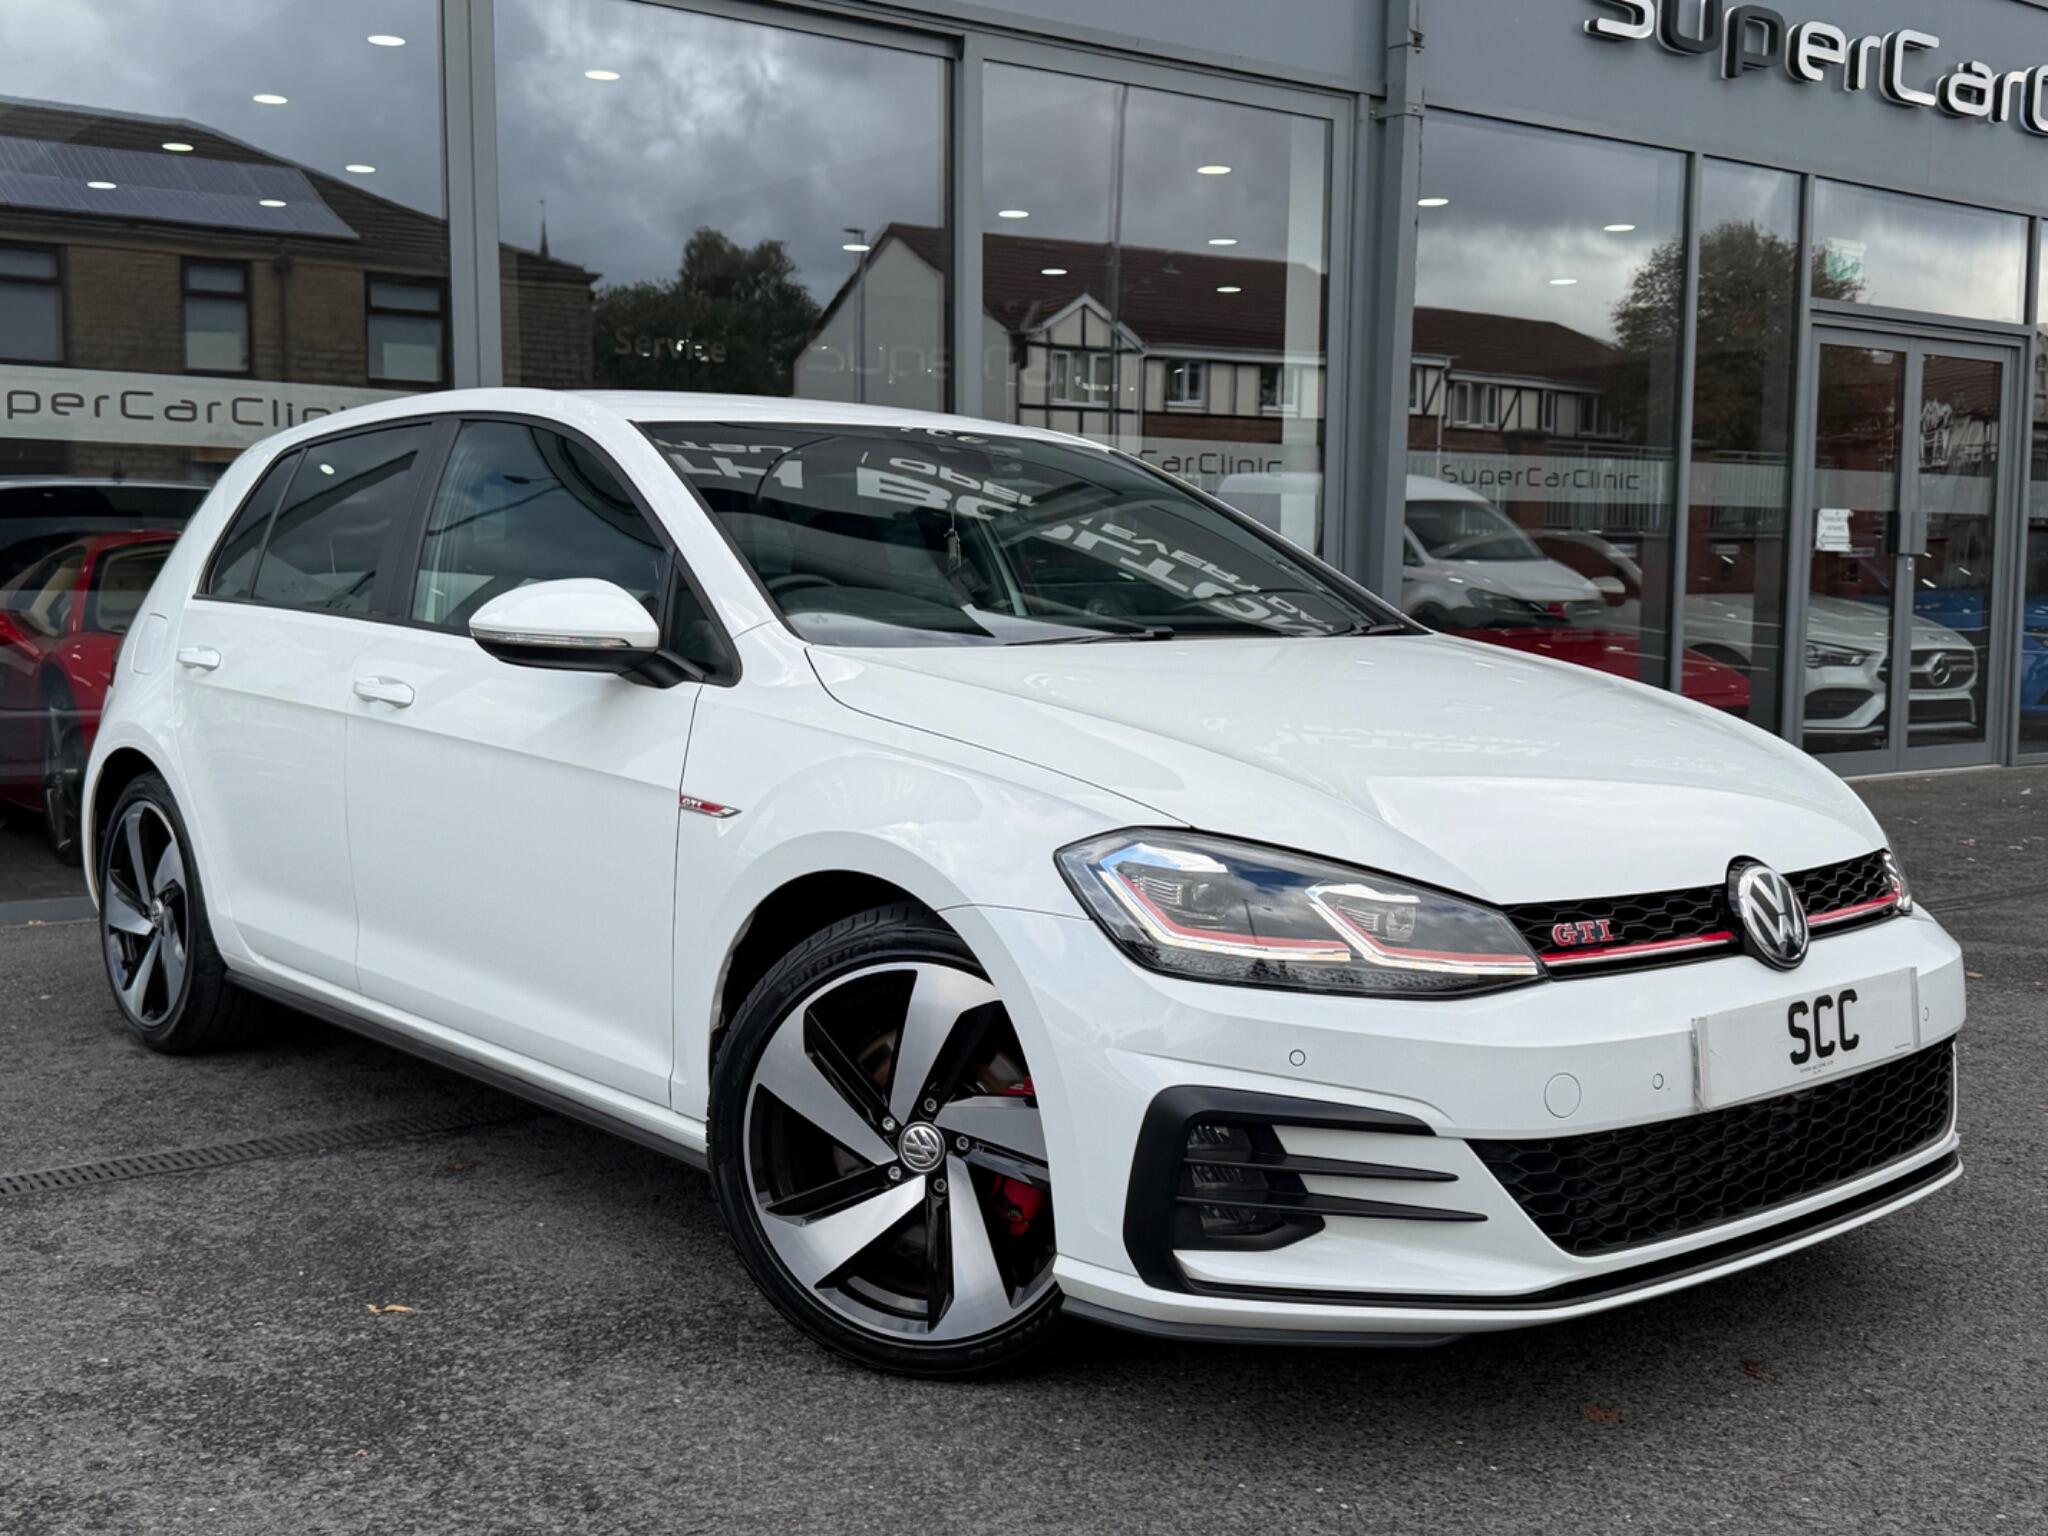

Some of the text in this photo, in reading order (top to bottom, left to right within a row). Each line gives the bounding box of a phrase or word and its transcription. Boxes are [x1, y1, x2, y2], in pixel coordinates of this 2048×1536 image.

[7, 389, 347, 428] perCarClin
[1441, 464, 1640, 490] SuperCarClinic
[1552, 918, 1614, 947] GTI
[1787, 988, 1860, 1066] SCC
